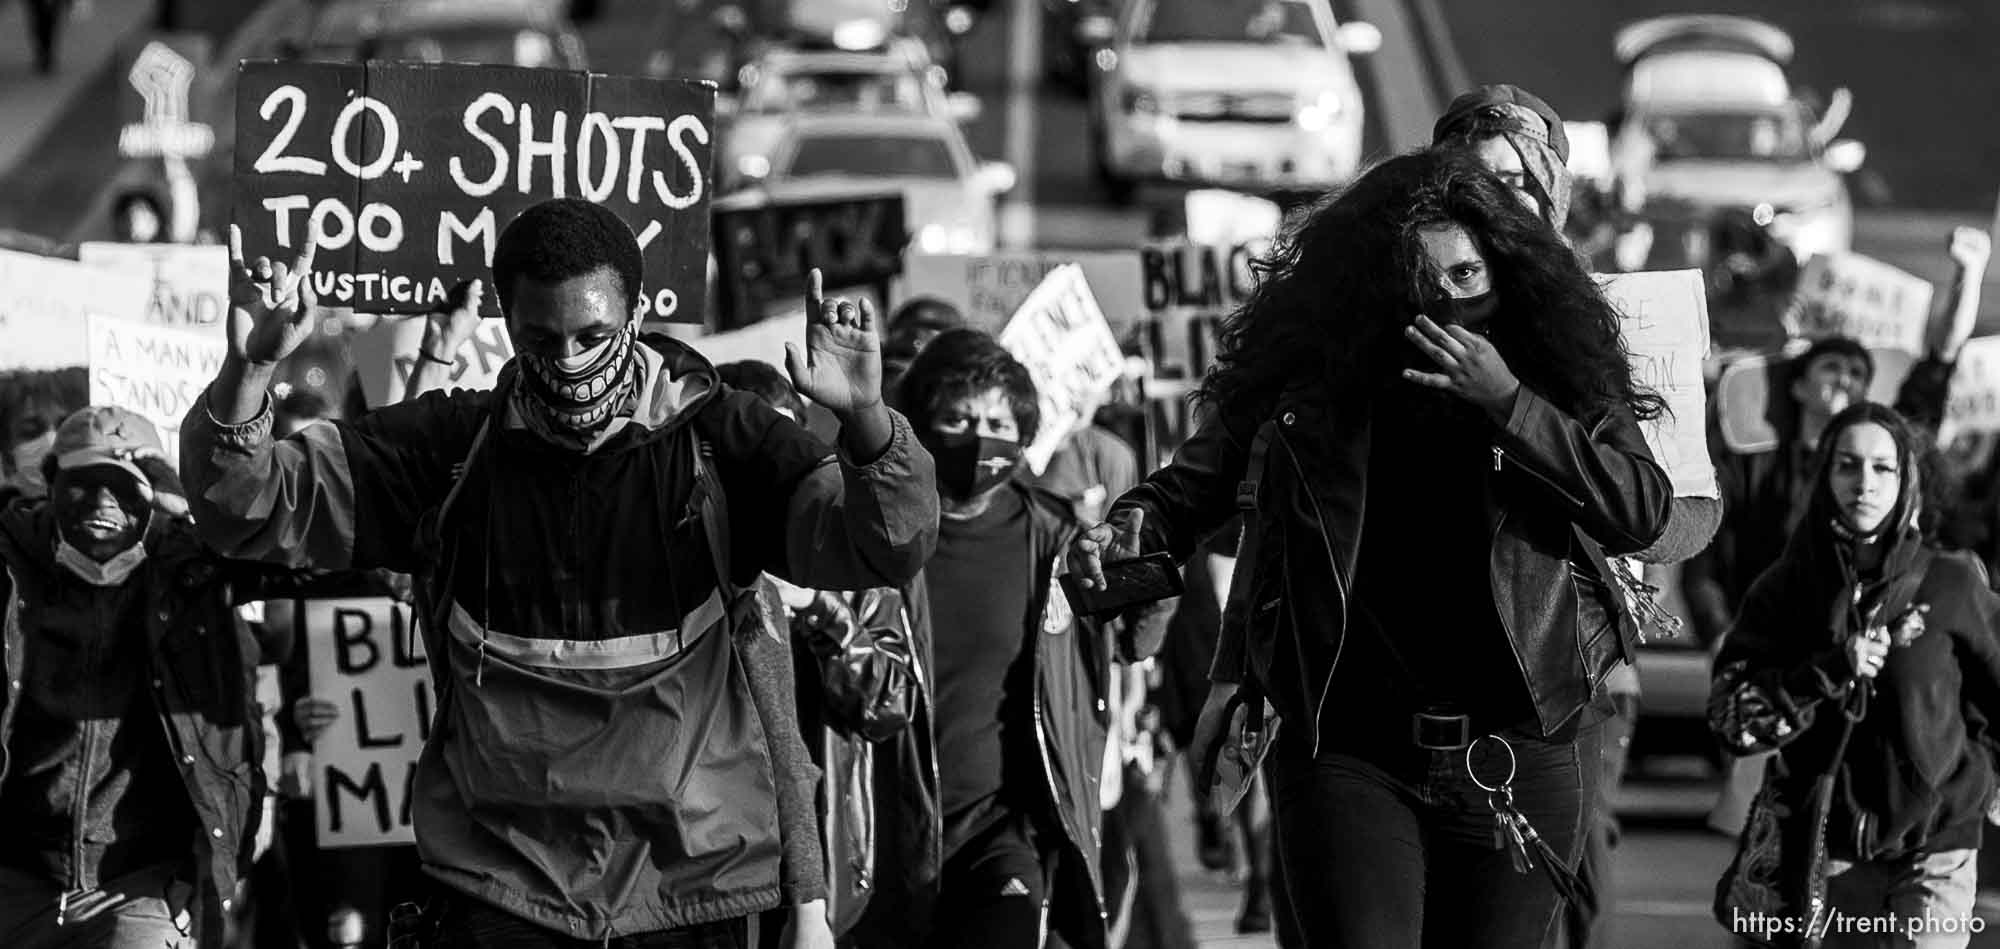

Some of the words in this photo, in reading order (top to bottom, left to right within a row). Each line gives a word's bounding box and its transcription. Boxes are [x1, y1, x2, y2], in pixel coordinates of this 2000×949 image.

[254, 85, 423, 183] 20+
[449, 92, 709, 209] SHOTS
[262, 195, 404, 253] TOO
[1145, 246, 1258, 311] BLAC
[146, 291, 220, 325] AND
[105, 328, 121, 361] A
[135, 334, 192, 369] MAN
